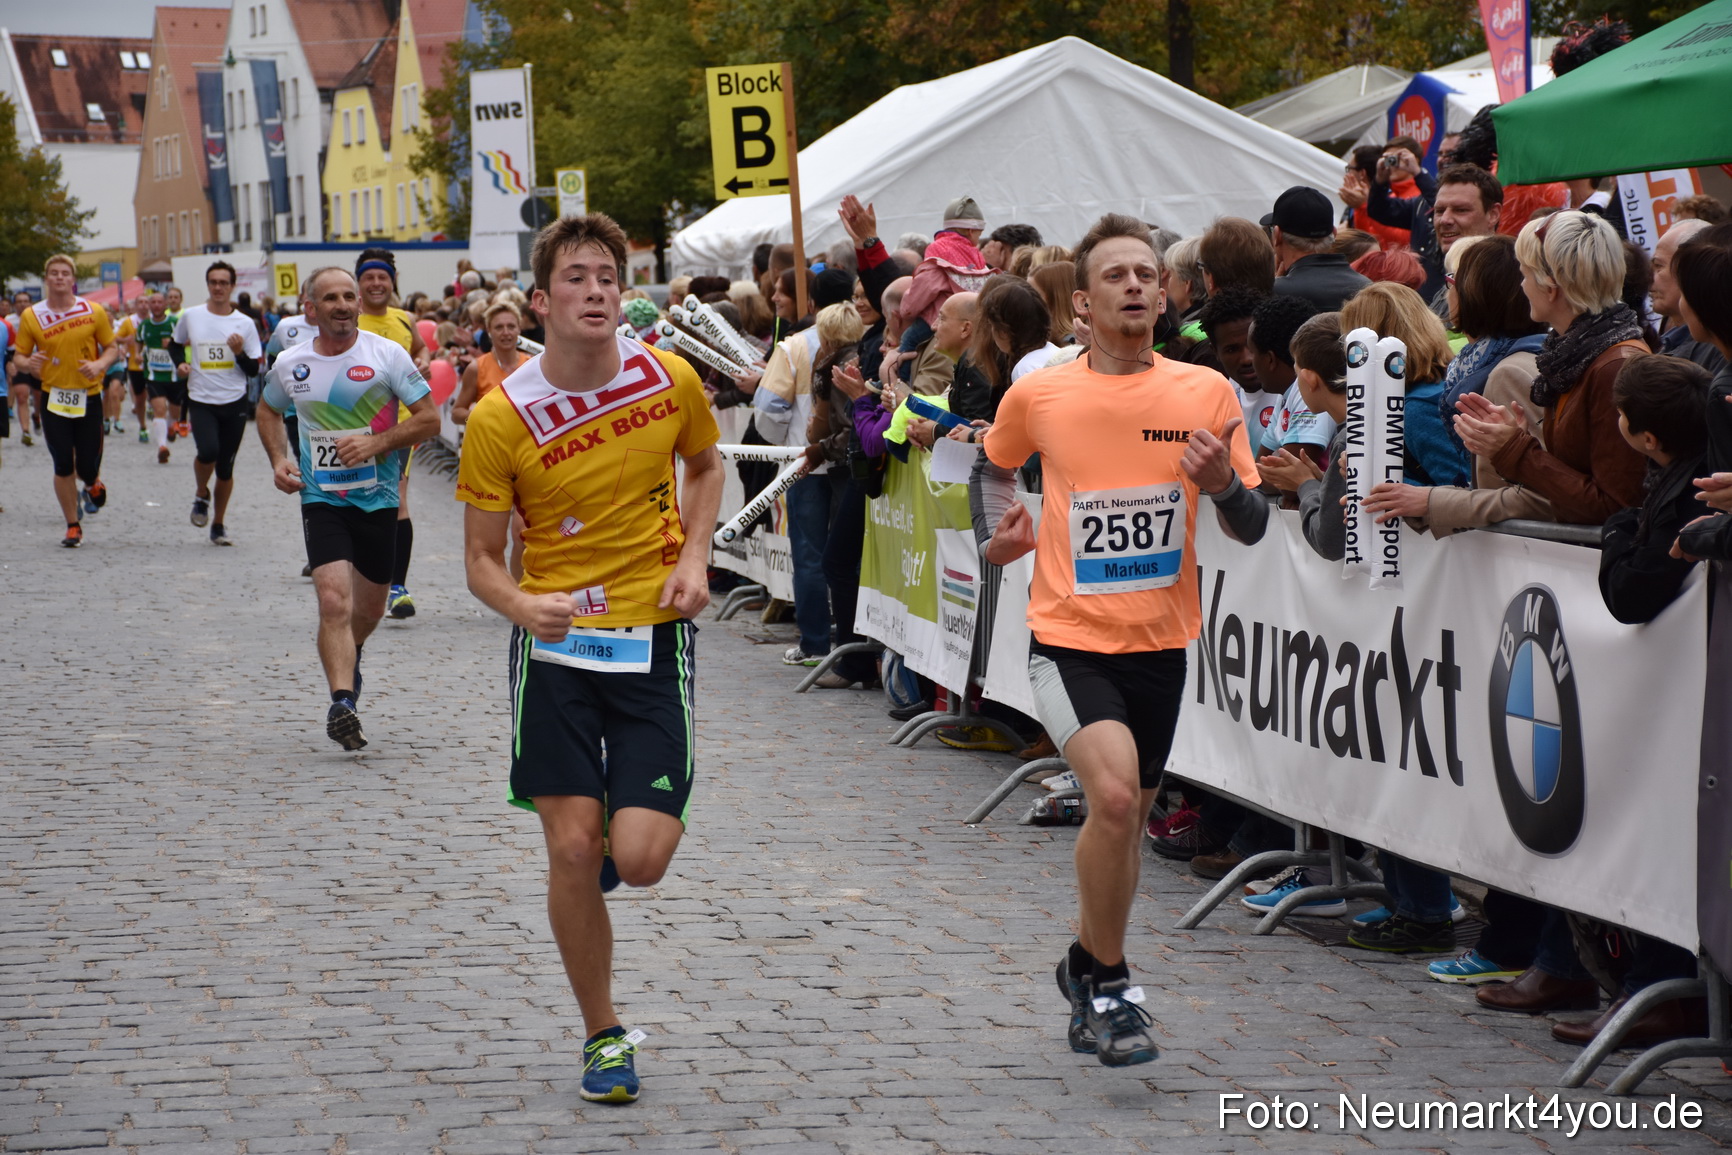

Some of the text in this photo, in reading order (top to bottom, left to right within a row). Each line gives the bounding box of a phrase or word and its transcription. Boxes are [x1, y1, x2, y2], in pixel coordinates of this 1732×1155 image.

[717, 69, 783, 96] Block
[732, 105, 776, 169] B
[281, 273, 292, 289] D
[44, 317, 95, 340] MAX BÖGL
[699, 313, 722, 338] BMW
[209, 347, 224, 360] 53
[678, 335, 742, 375] bmw-laufsport
[57, 391, 80, 405] 358
[540, 398, 680, 470] MAX BÖGL
[1142, 429, 1190, 443] THULE
[1386, 395, 1405, 459] BMW
[329, 472, 359, 482] Hubert
[1345, 384, 1365, 565] BMW Laufsport
[738, 499, 766, 528] BMW
[1072, 495, 1165, 511] PARTL Neumarkt
[1082, 508, 1174, 553] 2587
[1104, 561, 1159, 579] Markus
[568, 640, 613, 658] Jonas
[1500, 593, 1570, 685] BMW
[1197, 565, 1464, 787] Neumarkt
[651, 782, 673, 792] adidas
